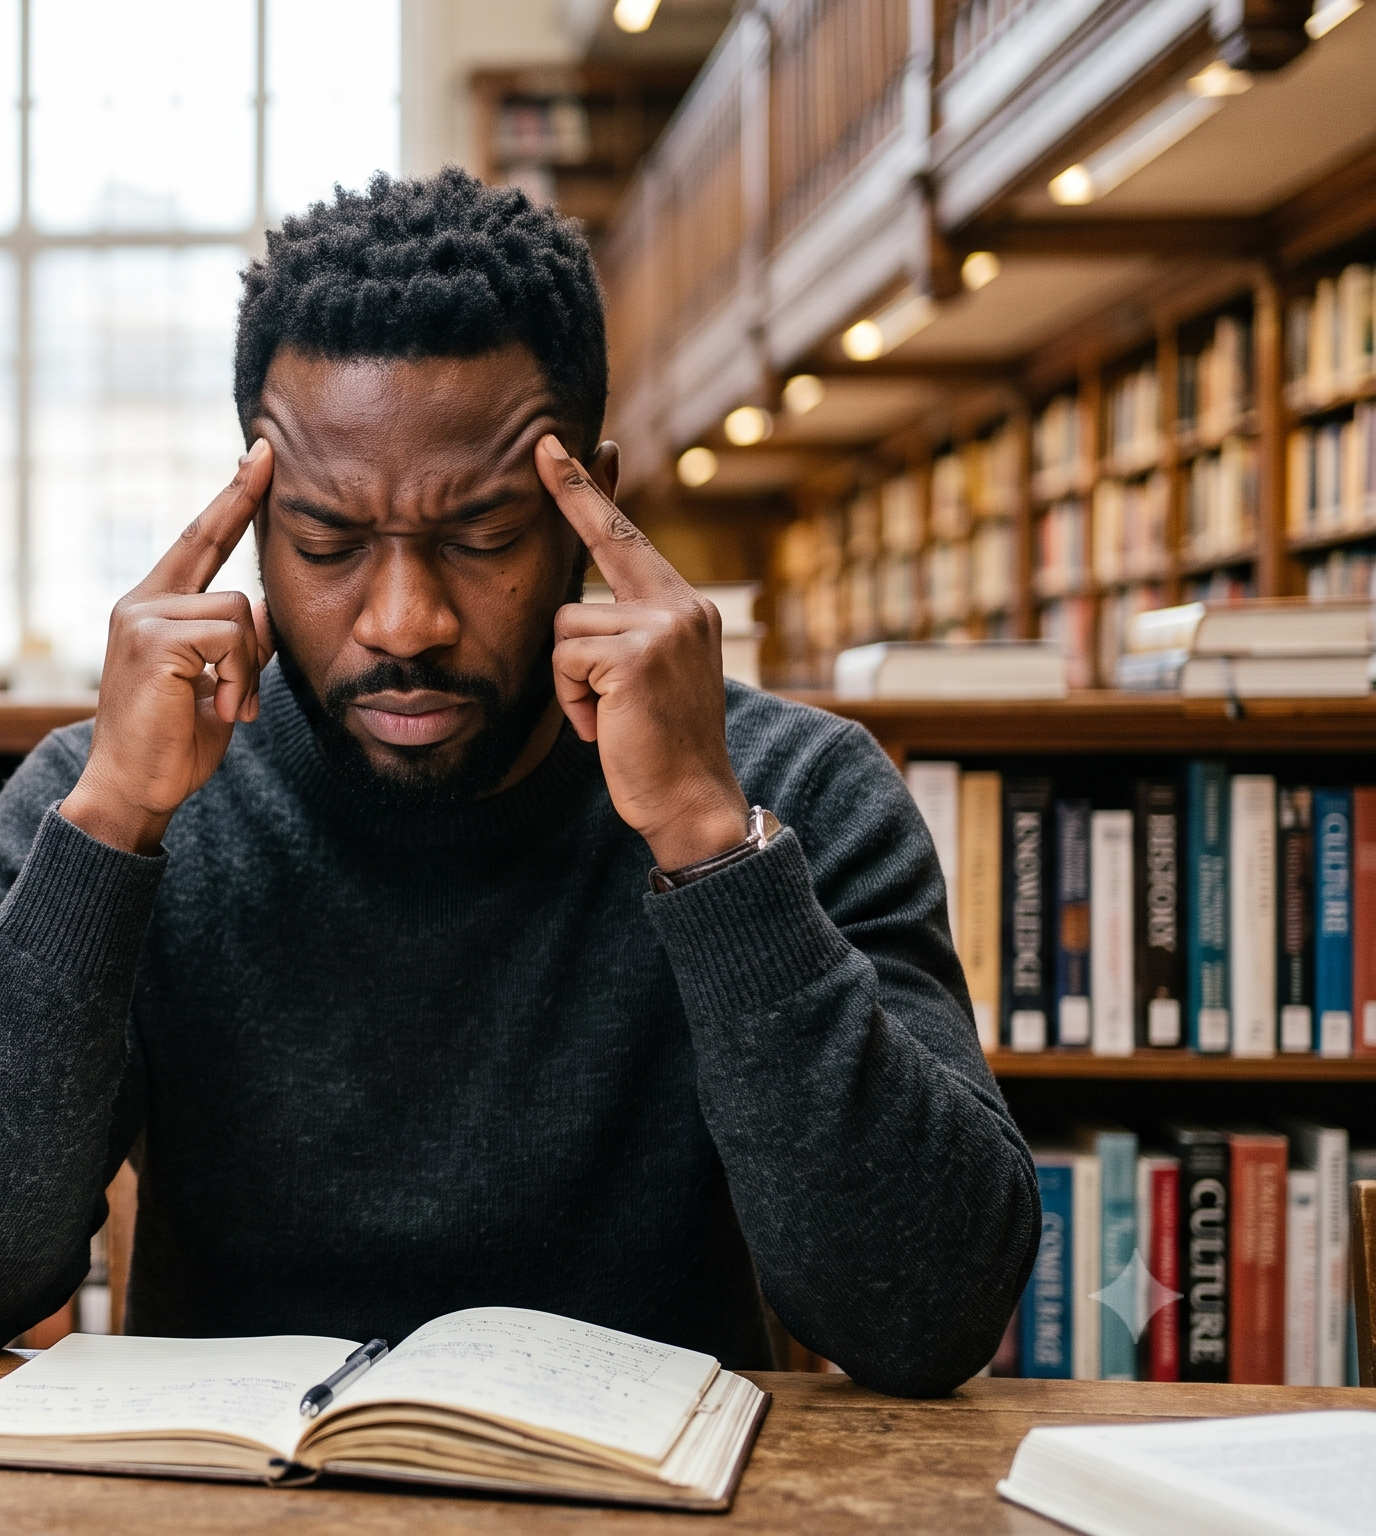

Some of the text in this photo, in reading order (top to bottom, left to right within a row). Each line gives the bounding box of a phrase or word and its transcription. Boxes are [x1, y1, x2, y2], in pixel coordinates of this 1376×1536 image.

[1013, 811, 1042, 996] KNOWLEDGE
[1147, 814, 1177, 953] HISTORY
[1321, 811, 1348, 938] CULTURE
[1189, 1178, 1226, 1364] CULTURE
